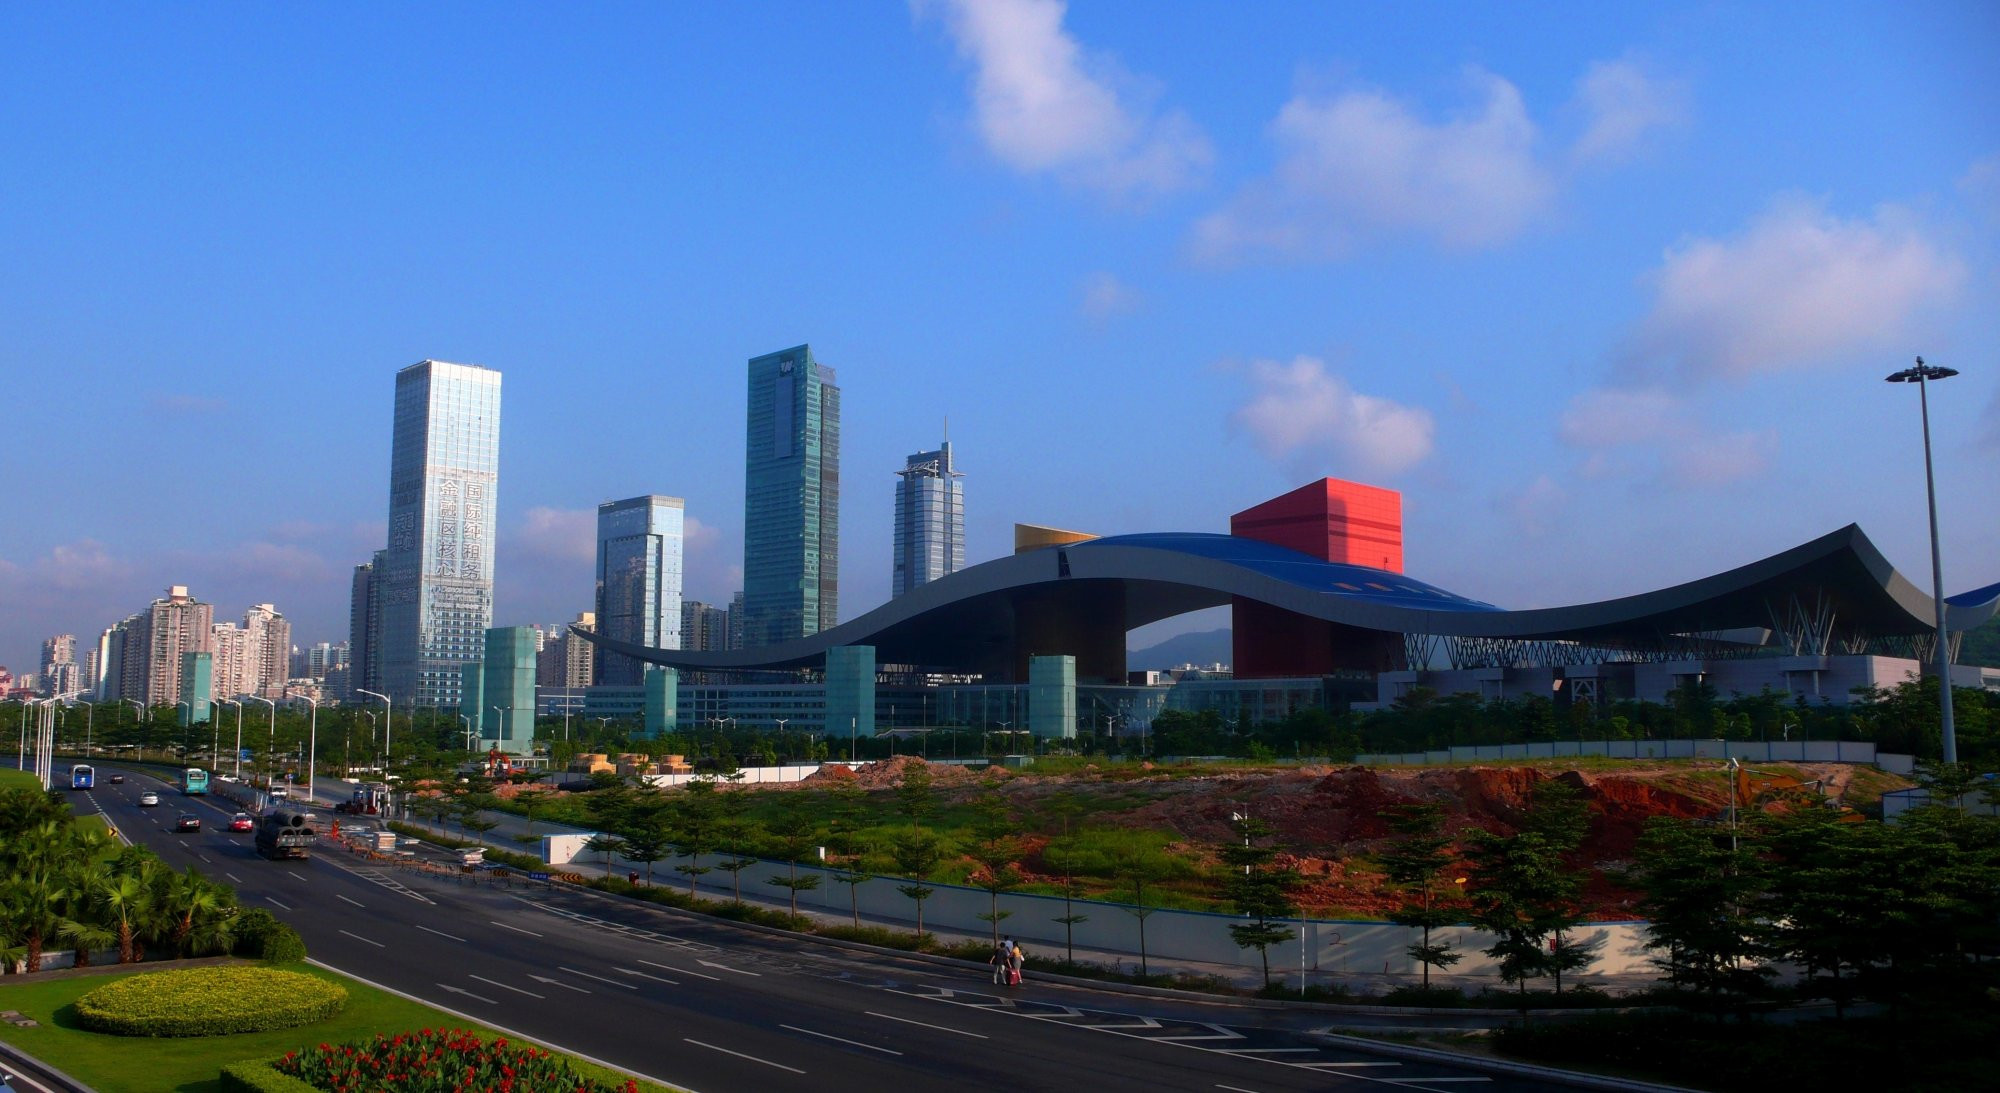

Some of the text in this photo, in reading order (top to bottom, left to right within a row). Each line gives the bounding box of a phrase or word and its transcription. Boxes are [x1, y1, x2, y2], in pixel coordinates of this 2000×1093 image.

[436, 480, 459, 578] 金融区核心
[461, 482, 483, 580] 国际纯租务
